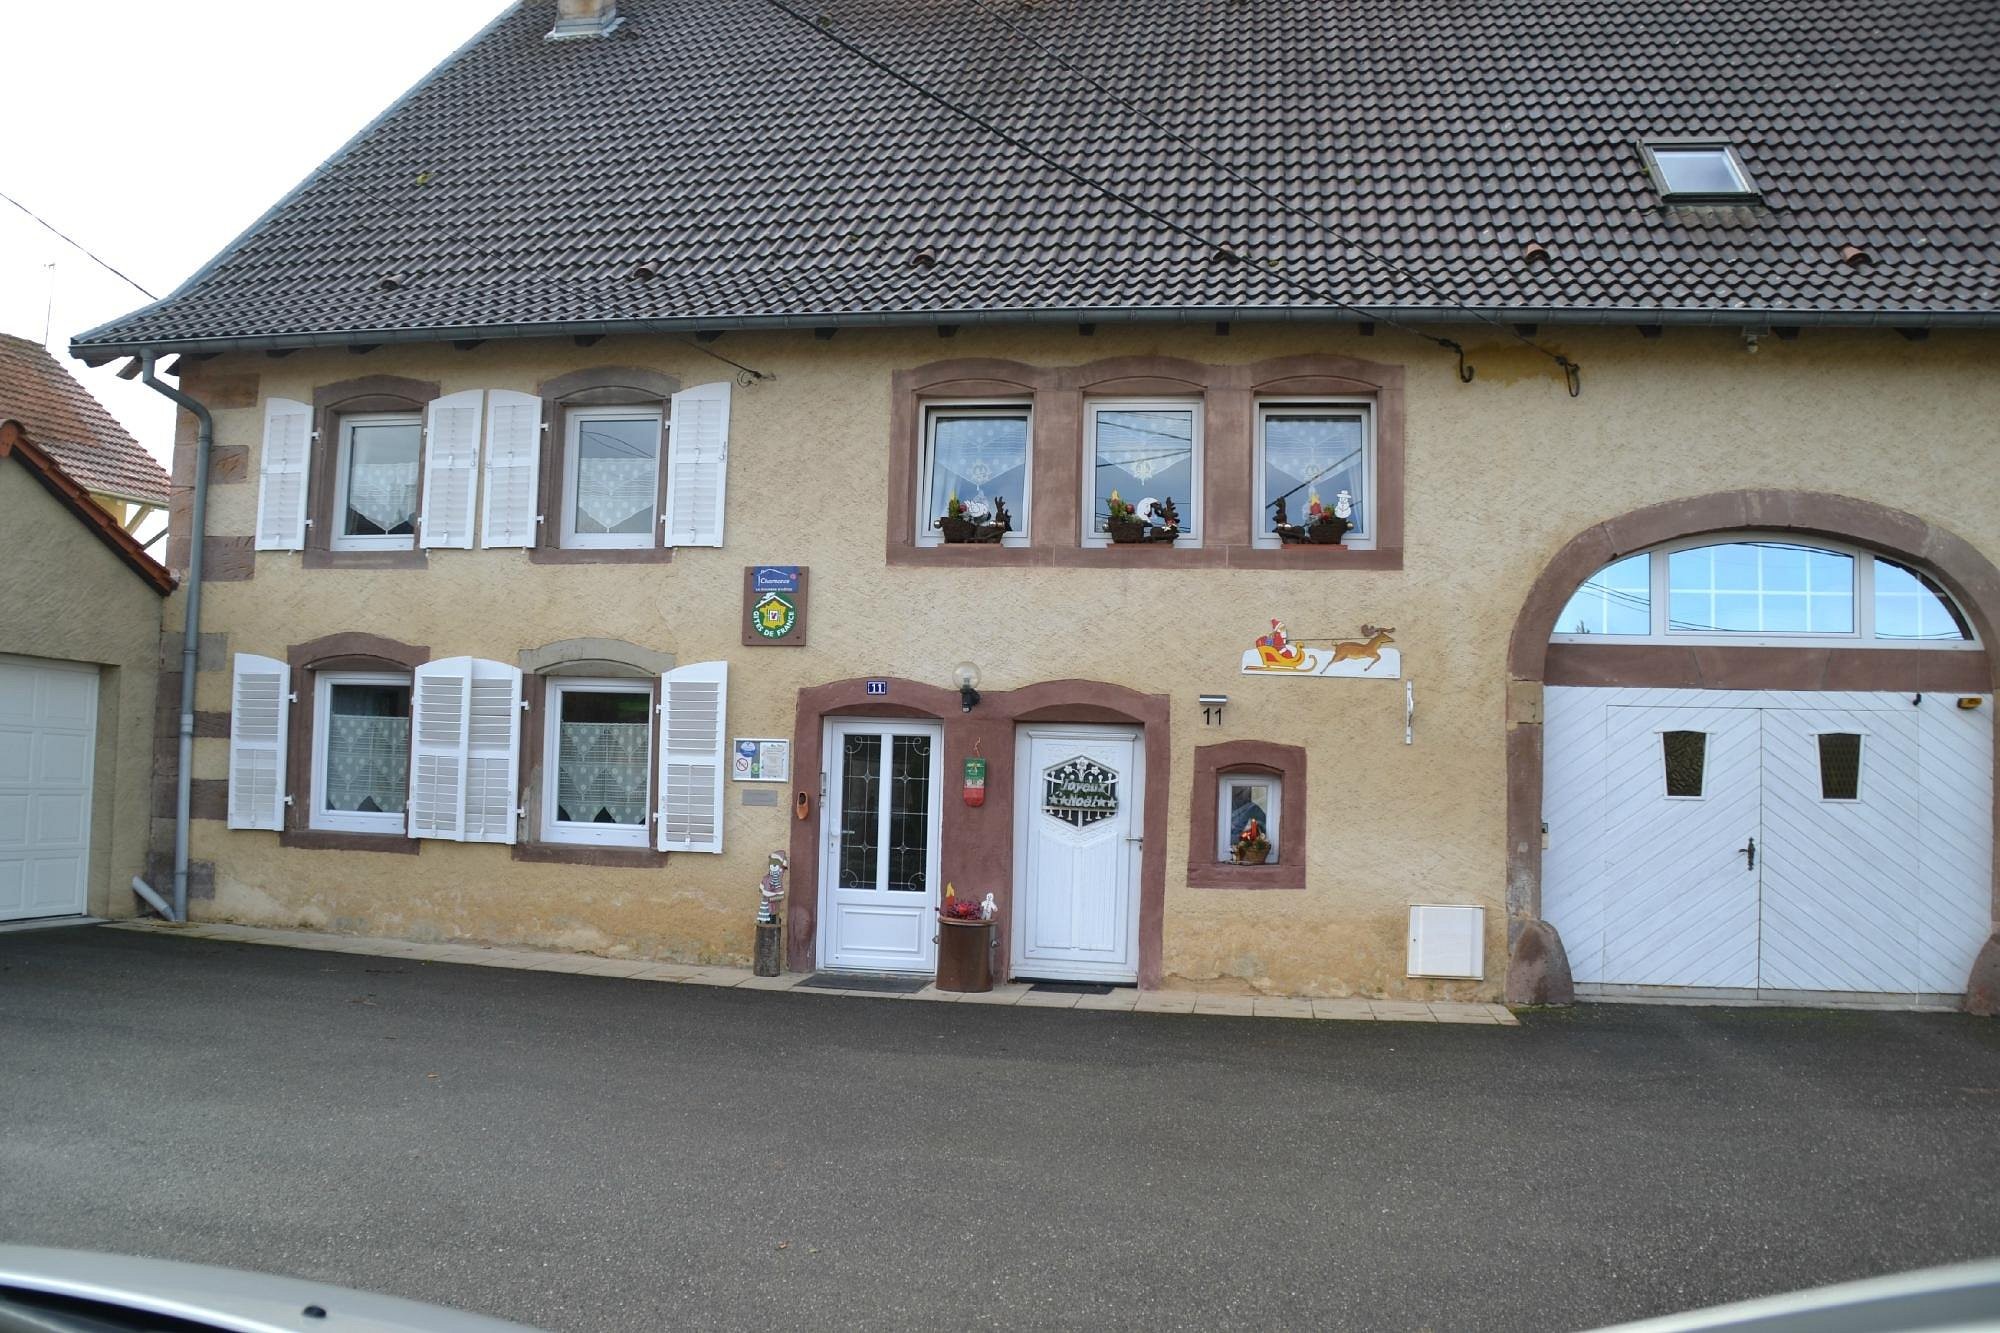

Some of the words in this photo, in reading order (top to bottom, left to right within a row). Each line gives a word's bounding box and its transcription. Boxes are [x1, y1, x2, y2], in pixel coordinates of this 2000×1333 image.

[763, 629, 775, 638] DE
[776, 611, 795, 637] FRANCE
[1202, 707, 1222, 726] 11
[1061, 779, 1110, 796] Joyeux
